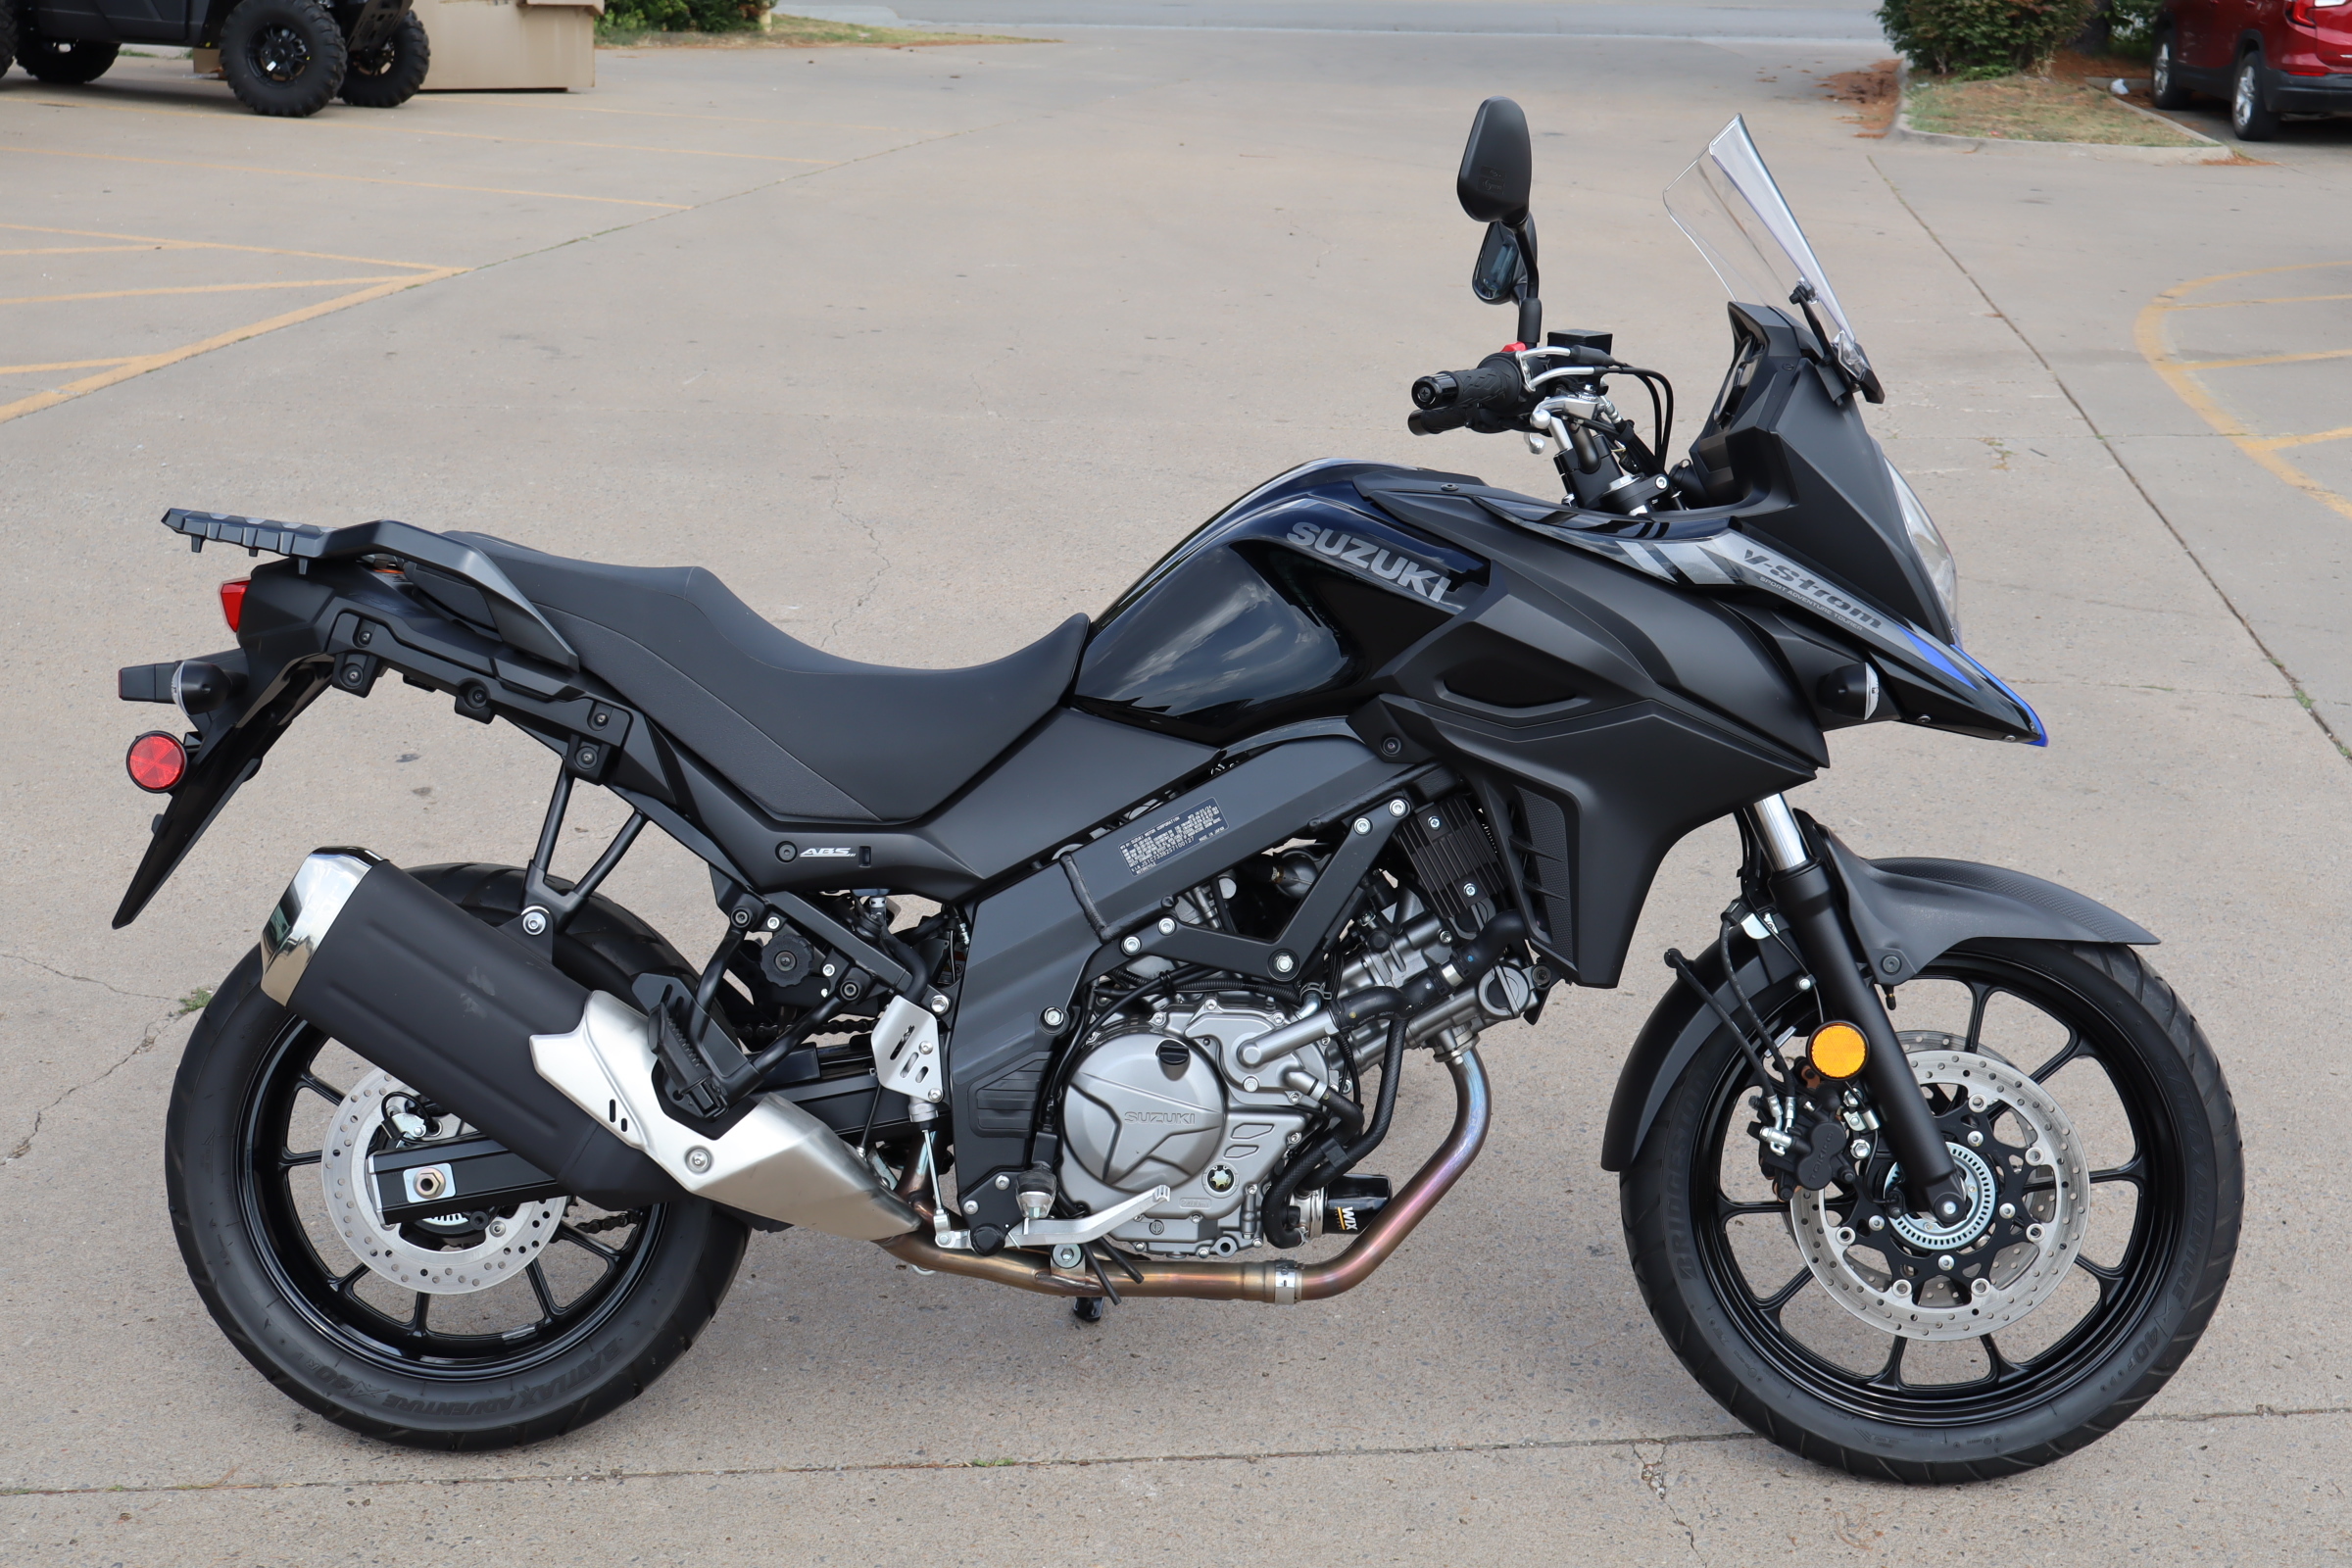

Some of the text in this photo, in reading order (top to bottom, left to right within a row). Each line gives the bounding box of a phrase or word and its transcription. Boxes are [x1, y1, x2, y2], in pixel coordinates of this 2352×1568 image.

[1286, 521, 1451, 603] SUZUKI
[1743, 549, 1883, 629] V-Strom
[1759, 576, 1863, 632] SPORT ADVENTURE TOURER
[800, 848, 856, 858] ABS
[1124, 1111, 1196, 1126] SUZUKI
[1343, 1206, 1358, 1231] WIX
[514, 1337, 624, 1409] BATTLAX
[381, 1392, 517, 1417] ADVENTURE
